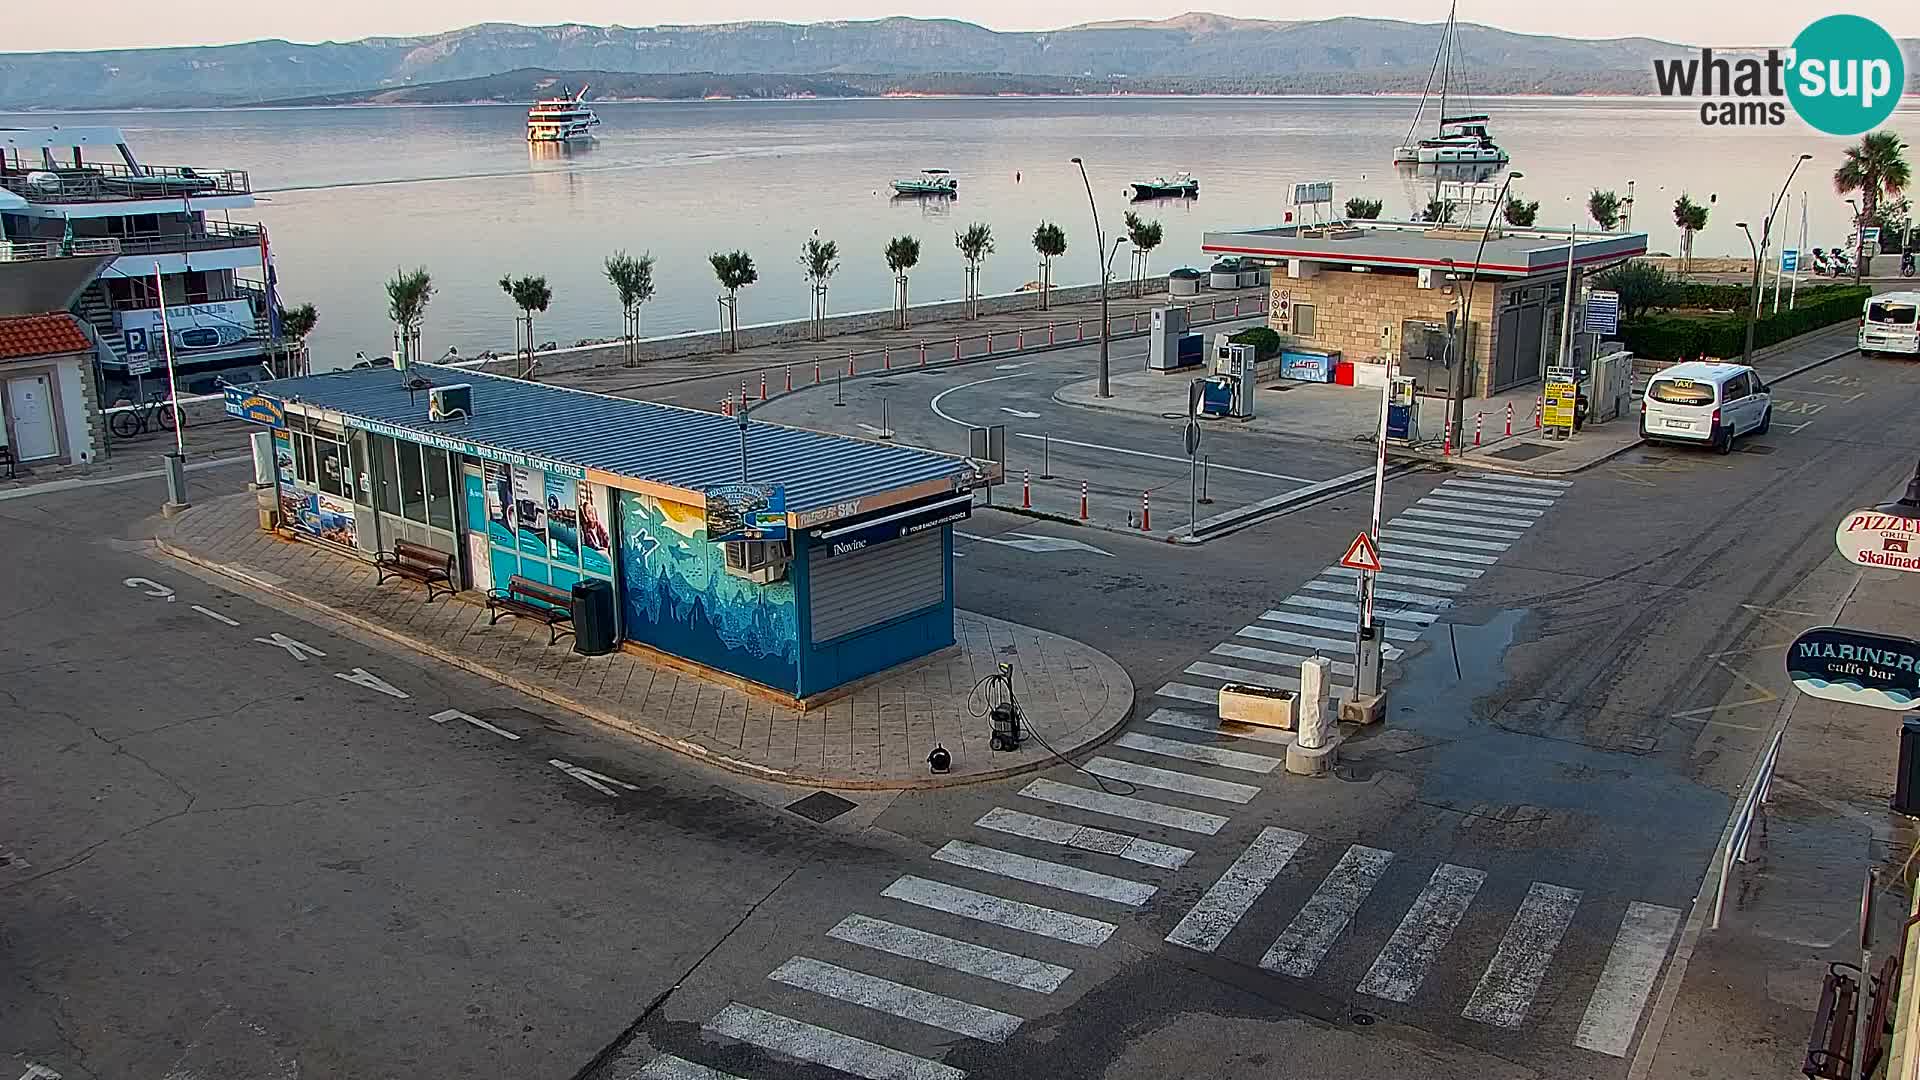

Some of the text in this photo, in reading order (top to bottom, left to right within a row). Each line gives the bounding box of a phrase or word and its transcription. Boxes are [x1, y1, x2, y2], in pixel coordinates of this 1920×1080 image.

[128, 331, 141, 350] P
[1674, 380, 1693, 388] TAXI
[396, 428, 435, 445] AUTOBUSNA
[435, 437, 467, 453] POSTAJA
[477, 447, 492, 458] BUS
[492, 451, 525, 465] STATION
[527, 457, 554, 471] TICKET
[554, 465, 581, 477] OFFICE
[1880, 530, 1915, 541] GRILL
[1827, 662, 1896, 680] caffe bar
